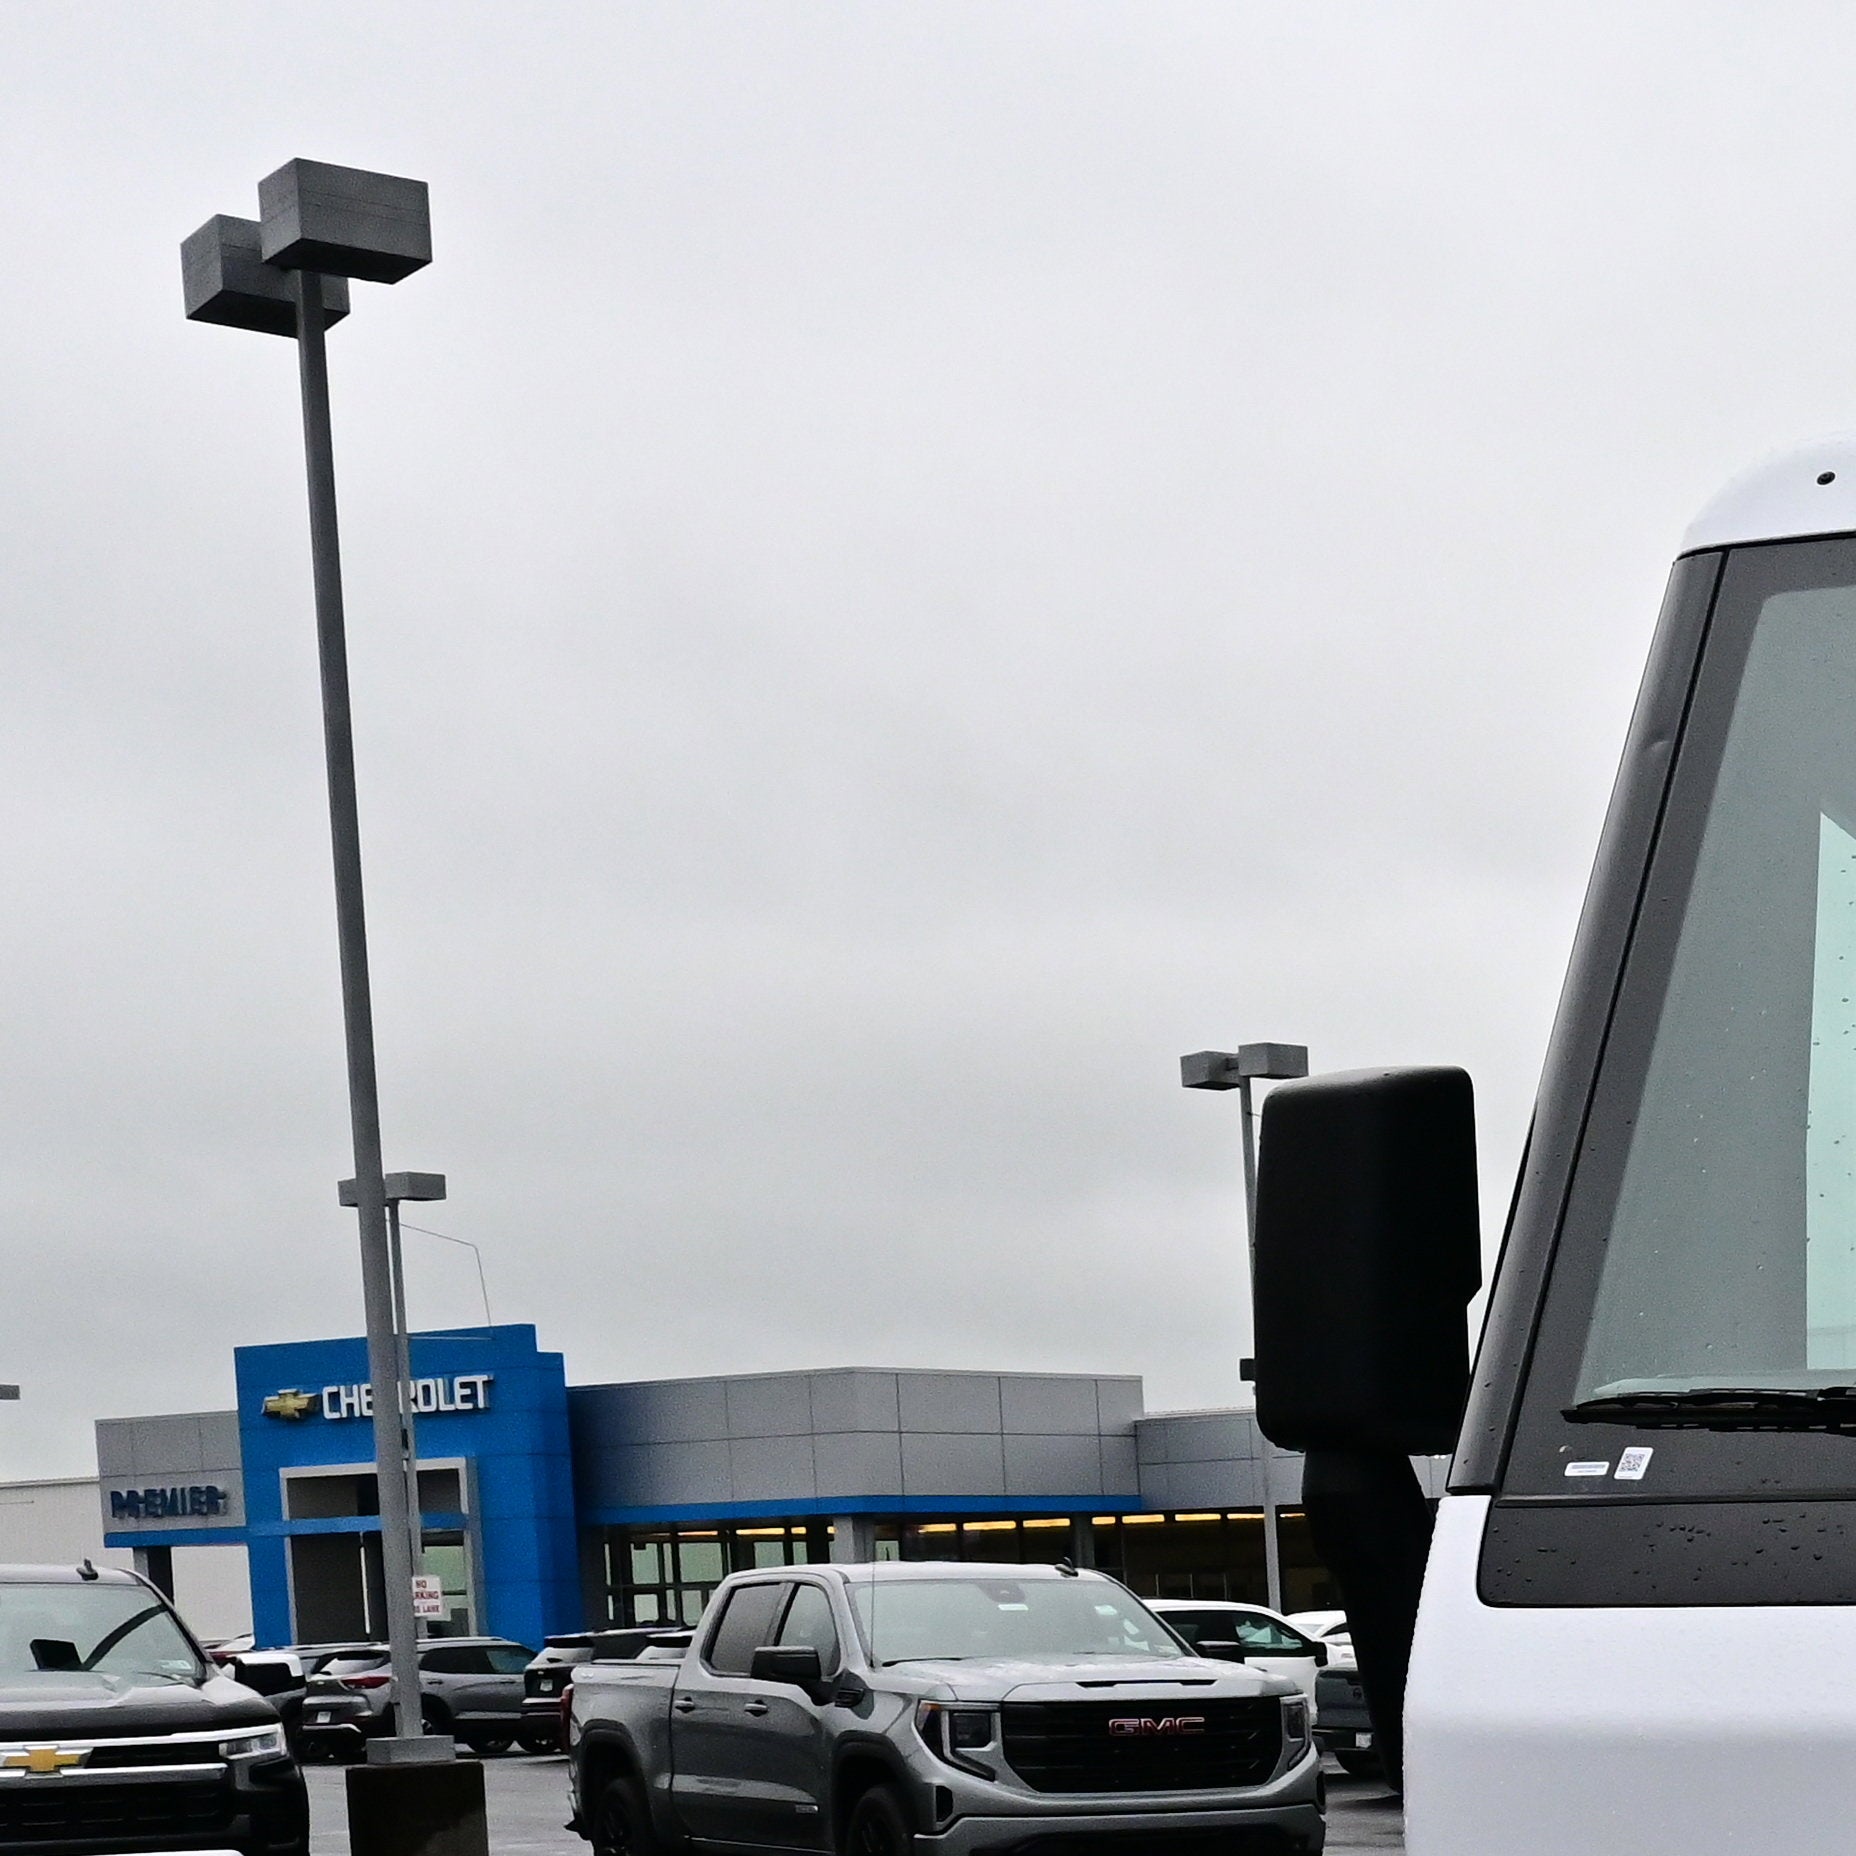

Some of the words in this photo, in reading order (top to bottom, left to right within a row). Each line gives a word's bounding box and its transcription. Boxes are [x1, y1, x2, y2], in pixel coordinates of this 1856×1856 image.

[322, 1375, 489, 1420] CHEROLET
[110, 1485, 227, 1519] PREMIER
[1108, 1716, 1205, 1736] GMC
